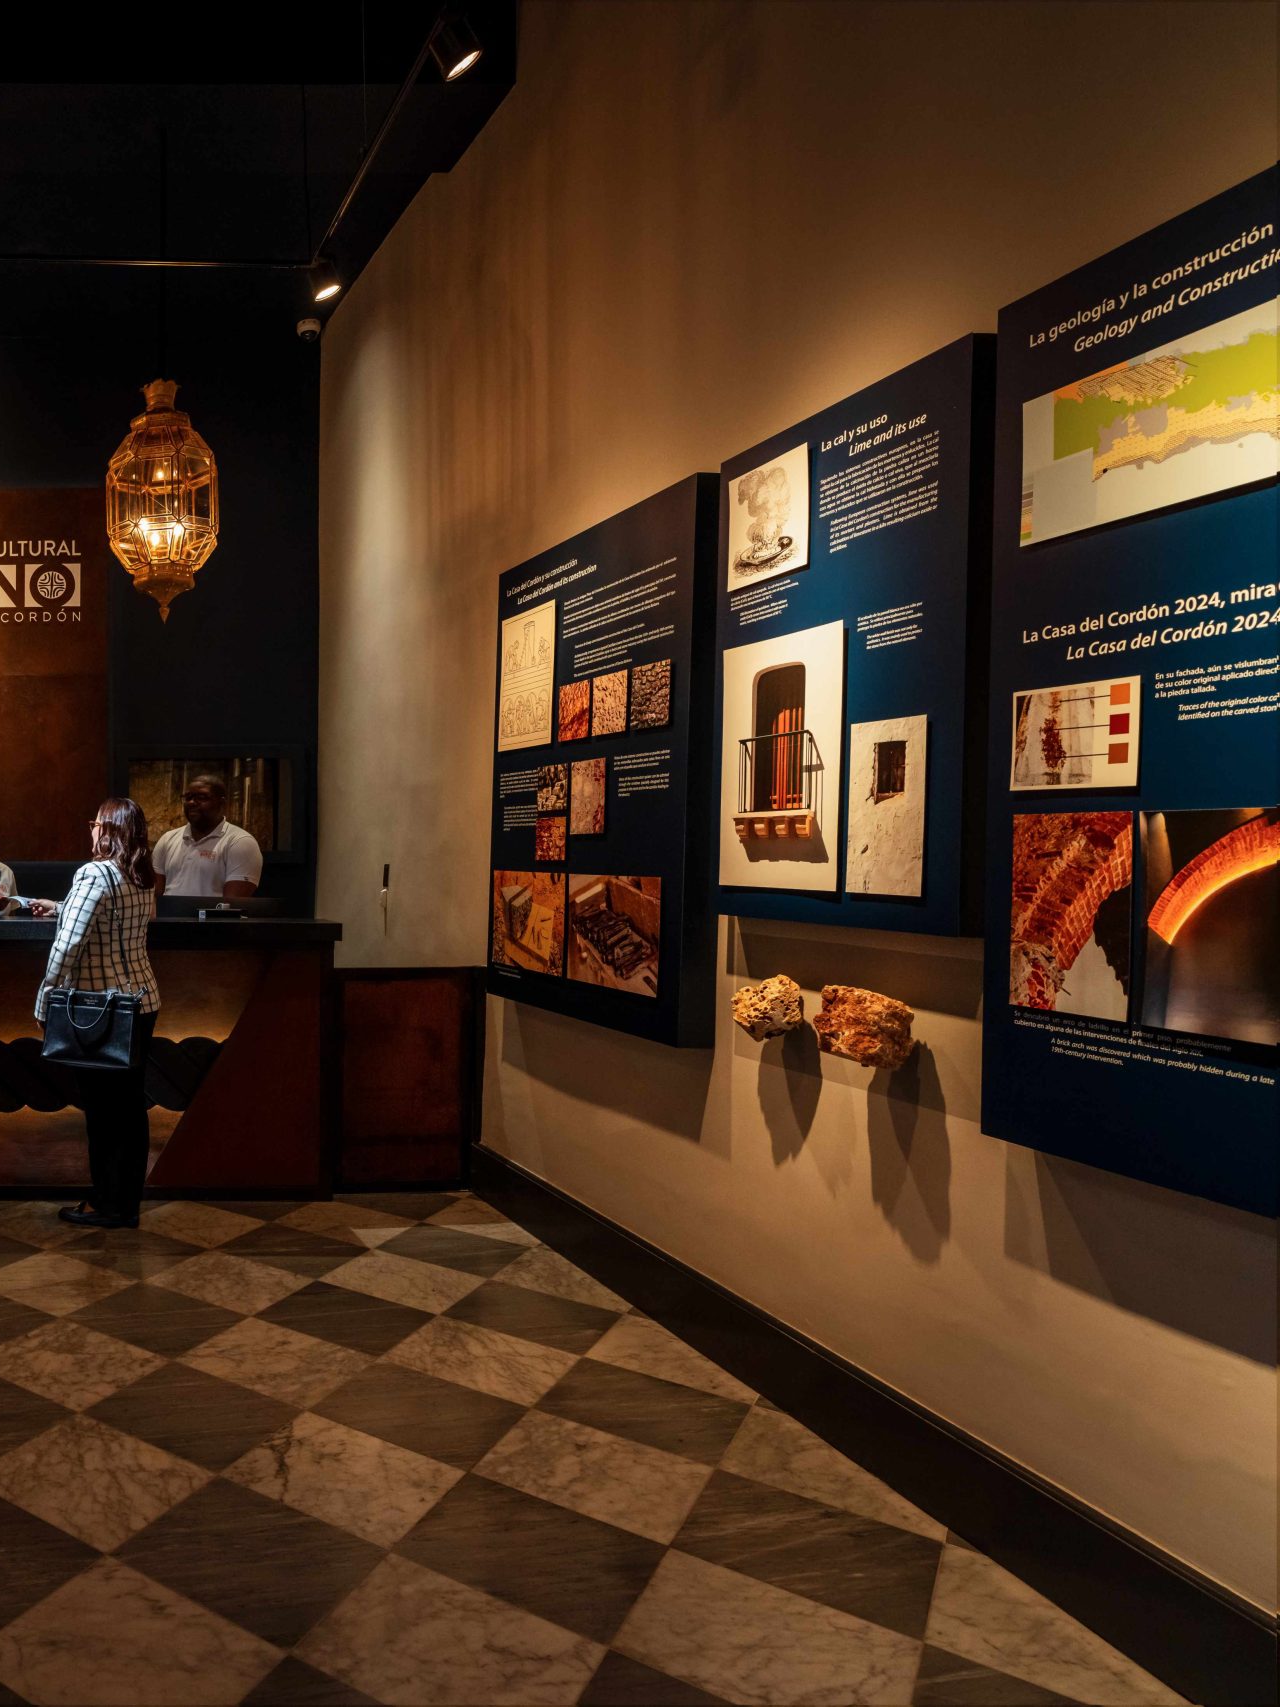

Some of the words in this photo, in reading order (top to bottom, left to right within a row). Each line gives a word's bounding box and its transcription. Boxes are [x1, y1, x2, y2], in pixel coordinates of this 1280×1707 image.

[1030, 332, 1045, 348] La
[1049, 298, 1115, 342] geología
[1119, 292, 1129, 310] y
[1133, 283, 1147, 299] la
[1152, 224, 1273, 289] construcción
[1074, 315, 1138, 352] Geology
[1141, 294, 1175, 323] and
[821, 440, 832, 452] La
[833, 430, 847, 446] cal
[848, 429, 855, 442] y
[856, 423, 868, 436] su
[869, 414, 888, 429] uso
[849, 439, 872, 457] Lime
[873, 425, 893, 446] and
[894, 422, 907, 436] its
[908, 414, 927, 430] use
[0, 608, 81, 623] CORDÓN
[1023, 630, 1038, 644] La
[1042, 624, 1076, 640] Casa
[1079, 614, 1104, 633] del
[1107, 603, 1169, 627] Cordón
[1174, 591, 1225, 615] 2024,
[1231, 583, 1276, 604] mira
[1066, 646, 1085, 660] La
[1088, 639, 1127, 656] Casa
[1130, 630, 1157, 649] del
[1160, 620, 1228, 644] Cordón
[1155, 672, 1164, 680] En
[1176, 667, 1205, 677] fachada,
[1207, 665, 1222, 673] aún
[1174, 678, 1192, 687] color
[1192, 674, 1221, 685] original
[1221, 669, 1254, 681] aplicado
